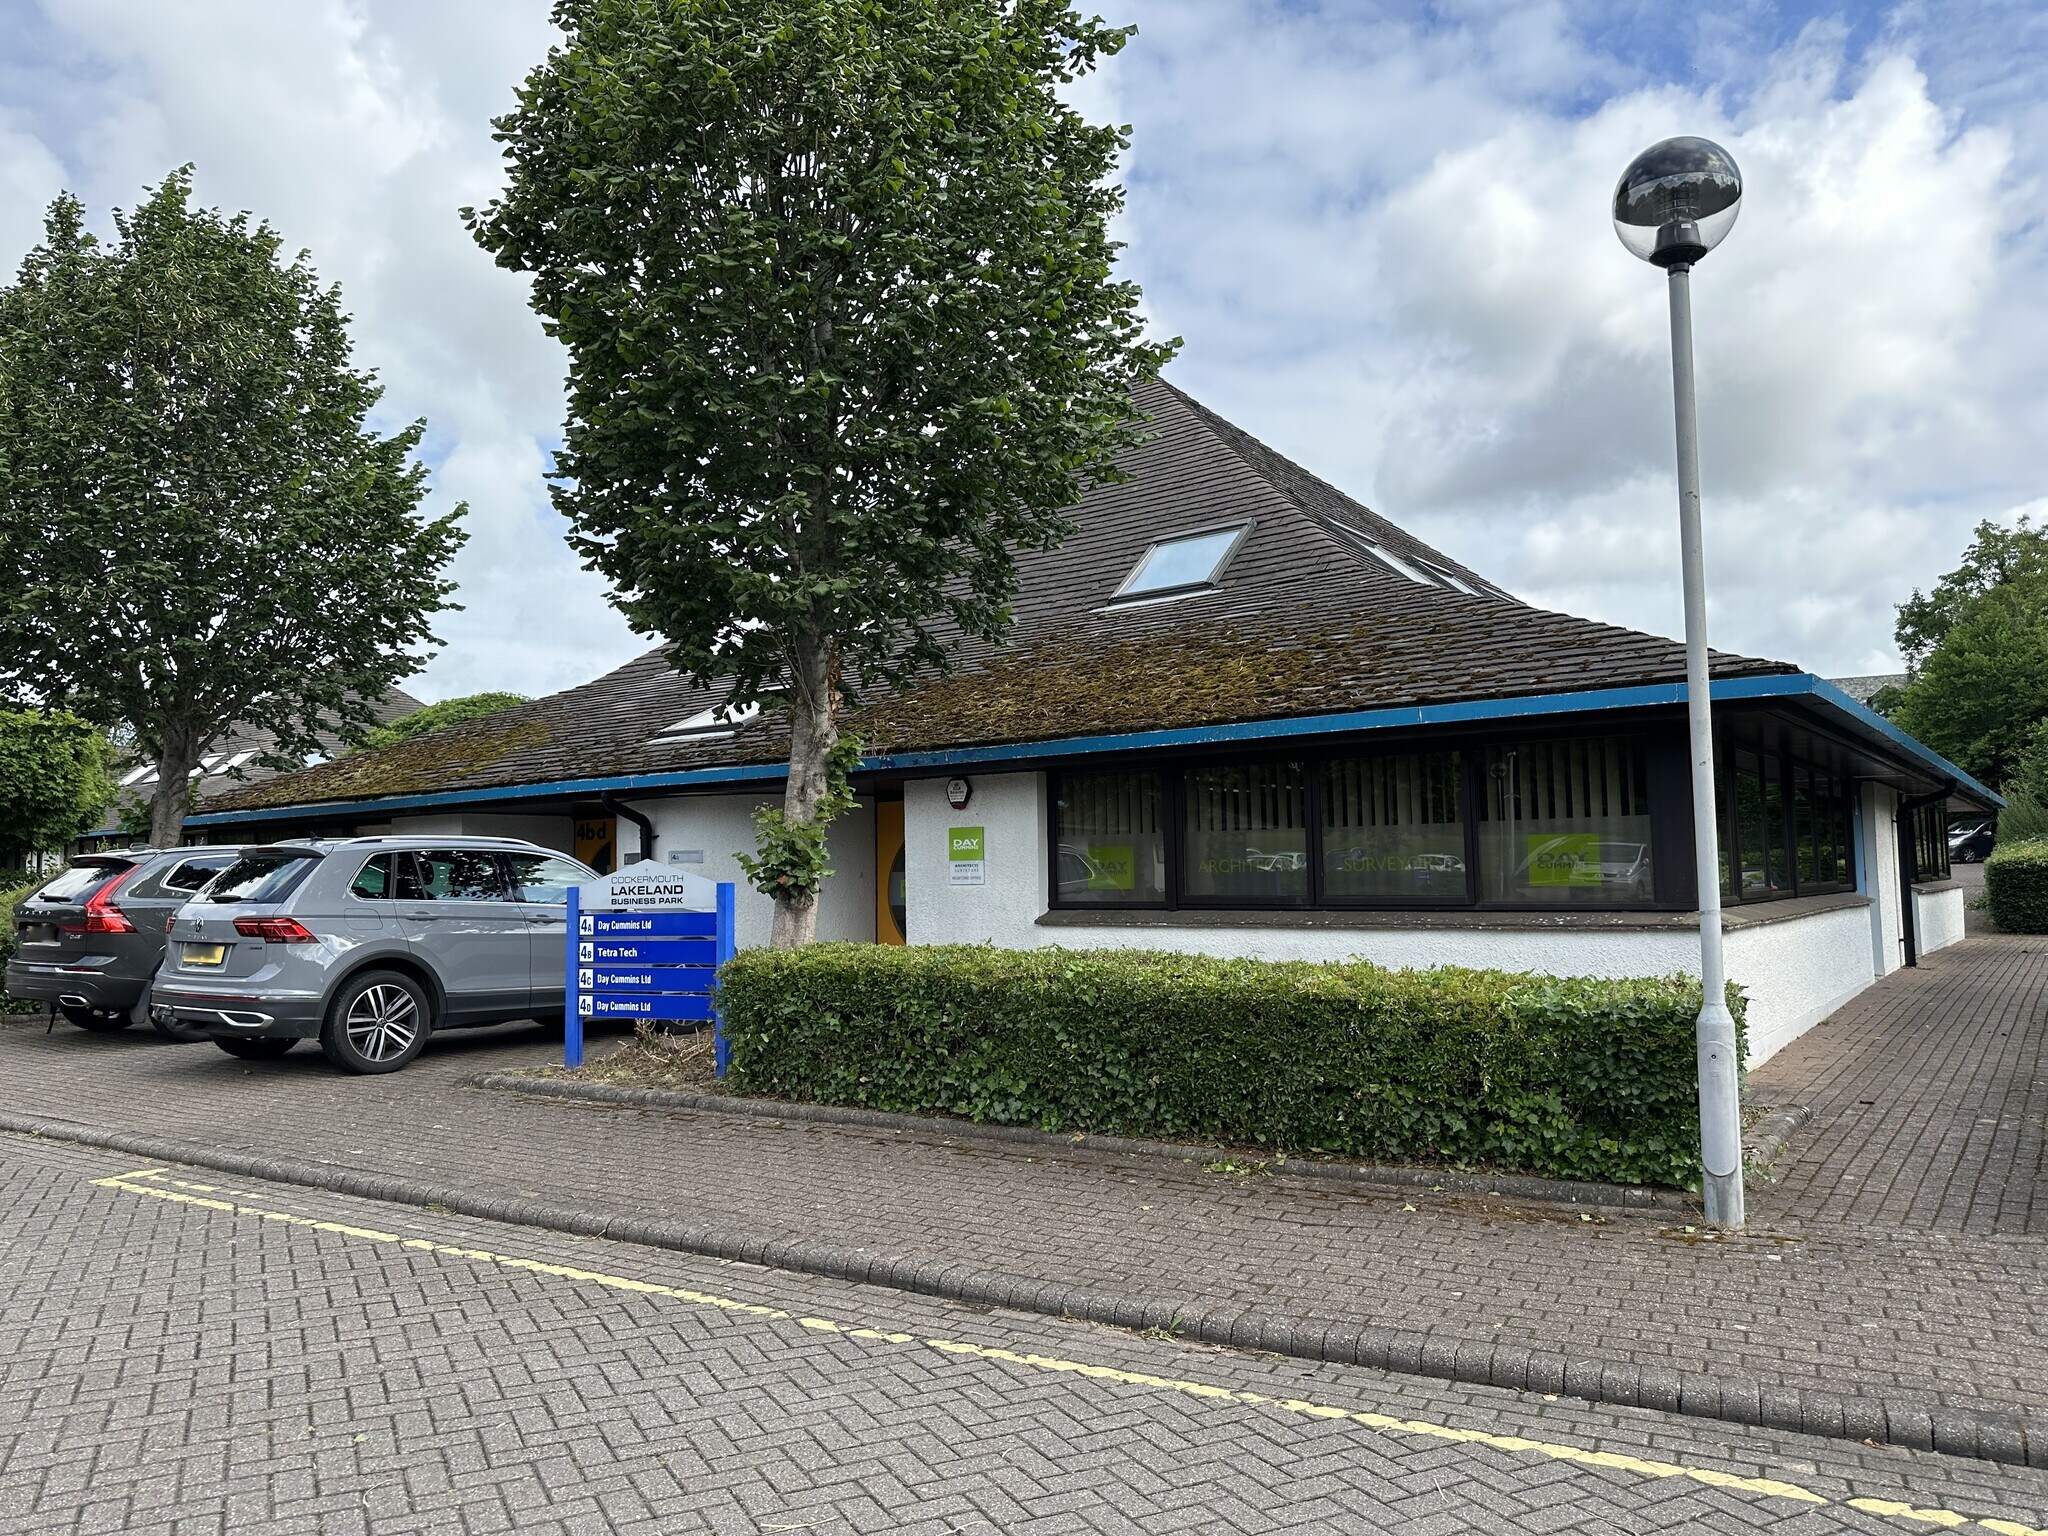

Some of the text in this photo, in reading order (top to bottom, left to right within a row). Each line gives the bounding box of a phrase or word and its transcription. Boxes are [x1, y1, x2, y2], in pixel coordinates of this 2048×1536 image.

[953, 838, 979, 846] DAY
[1537, 852, 1588, 862] DAY
[611, 875, 684, 884] COCKERMOUTH
[611, 885, 684, 896] LAKELAND
[581, 918, 652, 932] 4A Day Cummins Ltd
[581, 945, 638, 959] 4B Tetra Tech
[580, 972, 651, 985] 4C Day Cummins Ltd
[580, 998, 651, 1012] 4D Day Cummins Ltd
